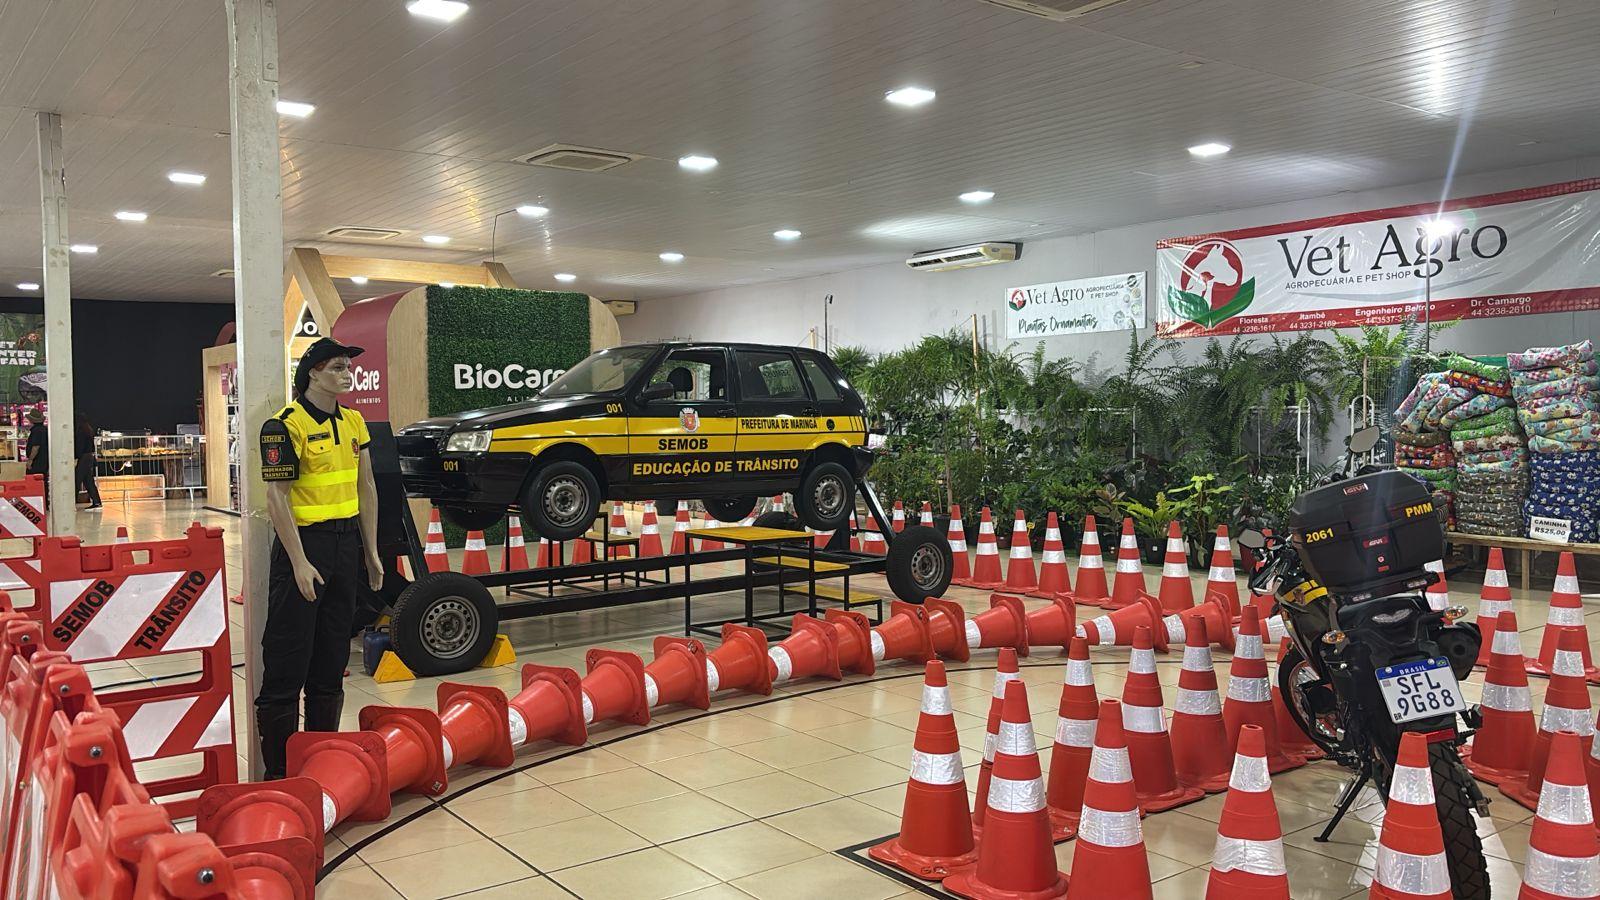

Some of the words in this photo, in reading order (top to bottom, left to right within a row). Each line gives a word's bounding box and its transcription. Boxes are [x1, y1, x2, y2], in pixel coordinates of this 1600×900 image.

[1277, 235, 1350, 278] Vet
[1370, 224, 1508, 279] Agro
[1285, 276, 1354, 290] AGROPECUÁRIA
[1356, 275, 1363, 283] E
[1365, 273, 1383, 283] PET
[1386, 270, 1412, 281] SHOP
[1026, 288, 1047, 305] Vet
[1051, 286, 1084, 306] Agro
[1239, 317, 1269, 325] Floresta
[1355, 306, 1402, 318] Engenheiro
[1470, 299, 1485, 307] Dr.
[1487, 295, 1532, 306] Camargo
[1471, 308, 1483, 316] 44
[1018, 318, 1048, 334] Plantas
[1049, 313, 1098, 332] Ornamentais
[606, 402, 623, 414] 001
[741, 418, 780, 430] PREFEITURA
[781, 418, 790, 429] DE
[790, 416, 818, 429] MARINGÁ
[658, 438, 708, 451] SEMOB
[443, 460, 459, 471] 001
[633, 459, 711, 477] EDUCAÇÃO
[715, 461, 732, 473] DE
[736, 458, 799, 473] TRÂNSITO
[8, 496, 42, 525] SEMOB
[1405, 502, 1433, 518] PMM
[1534, 519, 1567, 528] CAMINHA
[1306, 528, 1334, 543] 2061
[52, 579, 115, 643] SEMOB
[134, 570, 206, 650] TRÂNSITO
[1399, 664, 1427, 675] BRASIL
[1397, 672, 1441, 695] SFL
[1397, 689, 1455, 716] 9G88
[1394, 712, 1403, 721] BR
